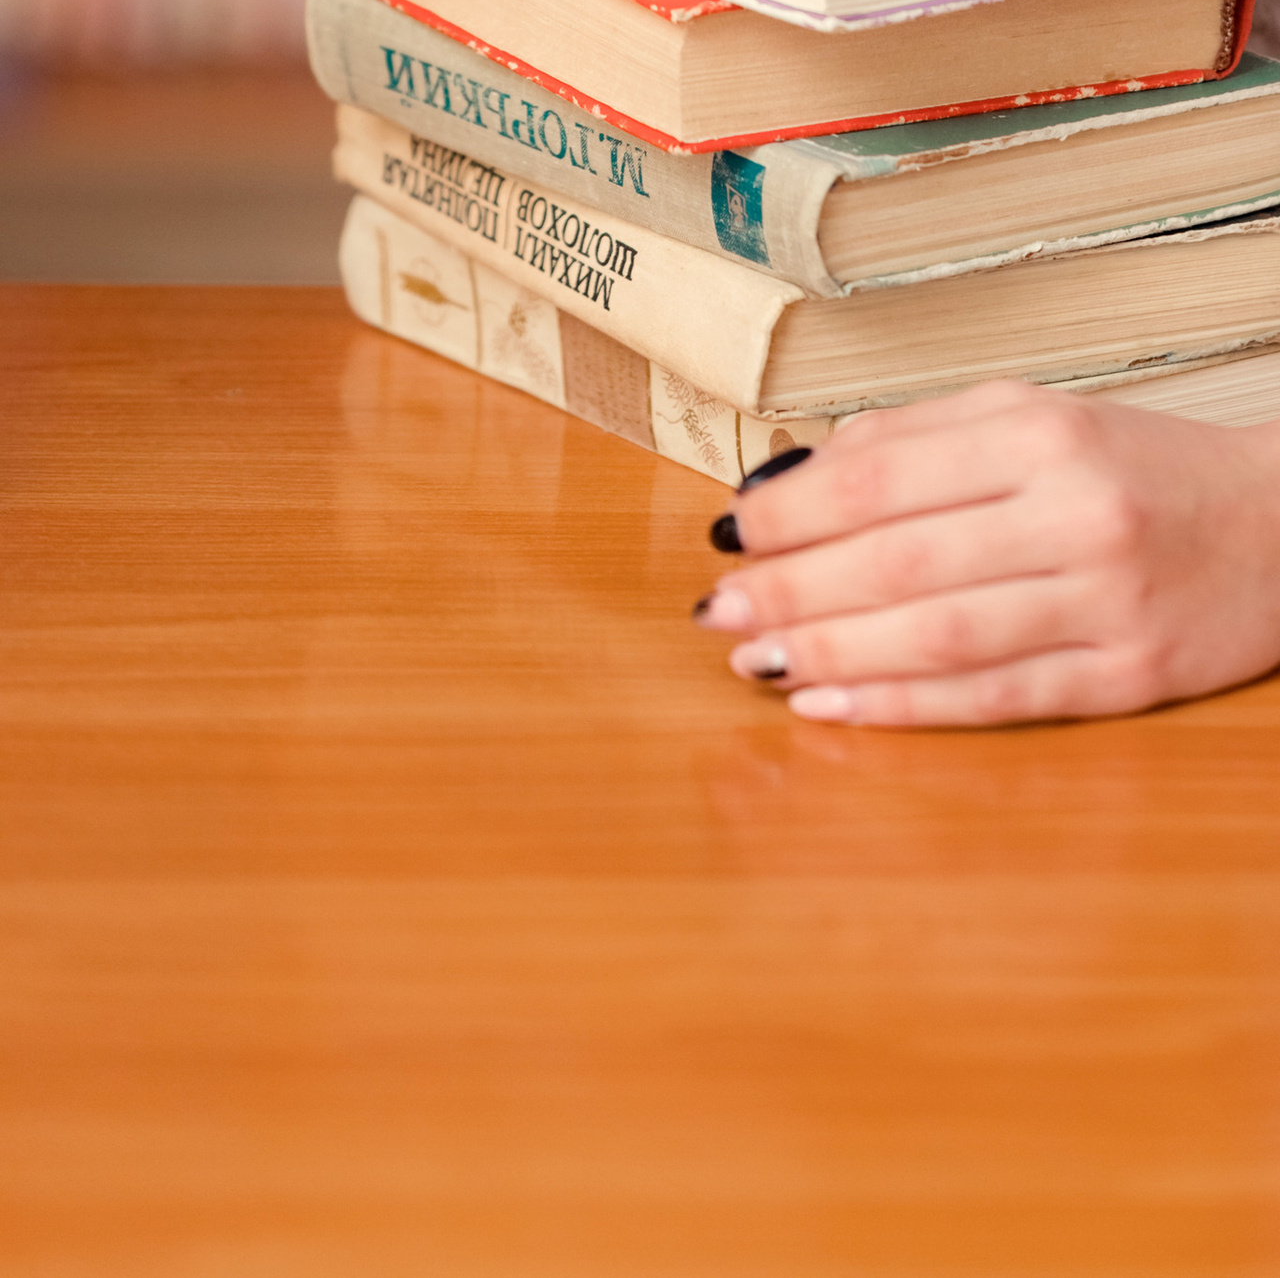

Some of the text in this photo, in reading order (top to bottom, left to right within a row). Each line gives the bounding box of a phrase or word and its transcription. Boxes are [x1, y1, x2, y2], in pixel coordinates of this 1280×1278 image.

[382, 152, 499, 242] ПОДНЯТАЯ
[410, 134, 506, 207] ЦЕЛИНА
[513, 225, 615, 311] МИХАИЛ
[517, 189, 638, 281] ШОЛОХОВ
